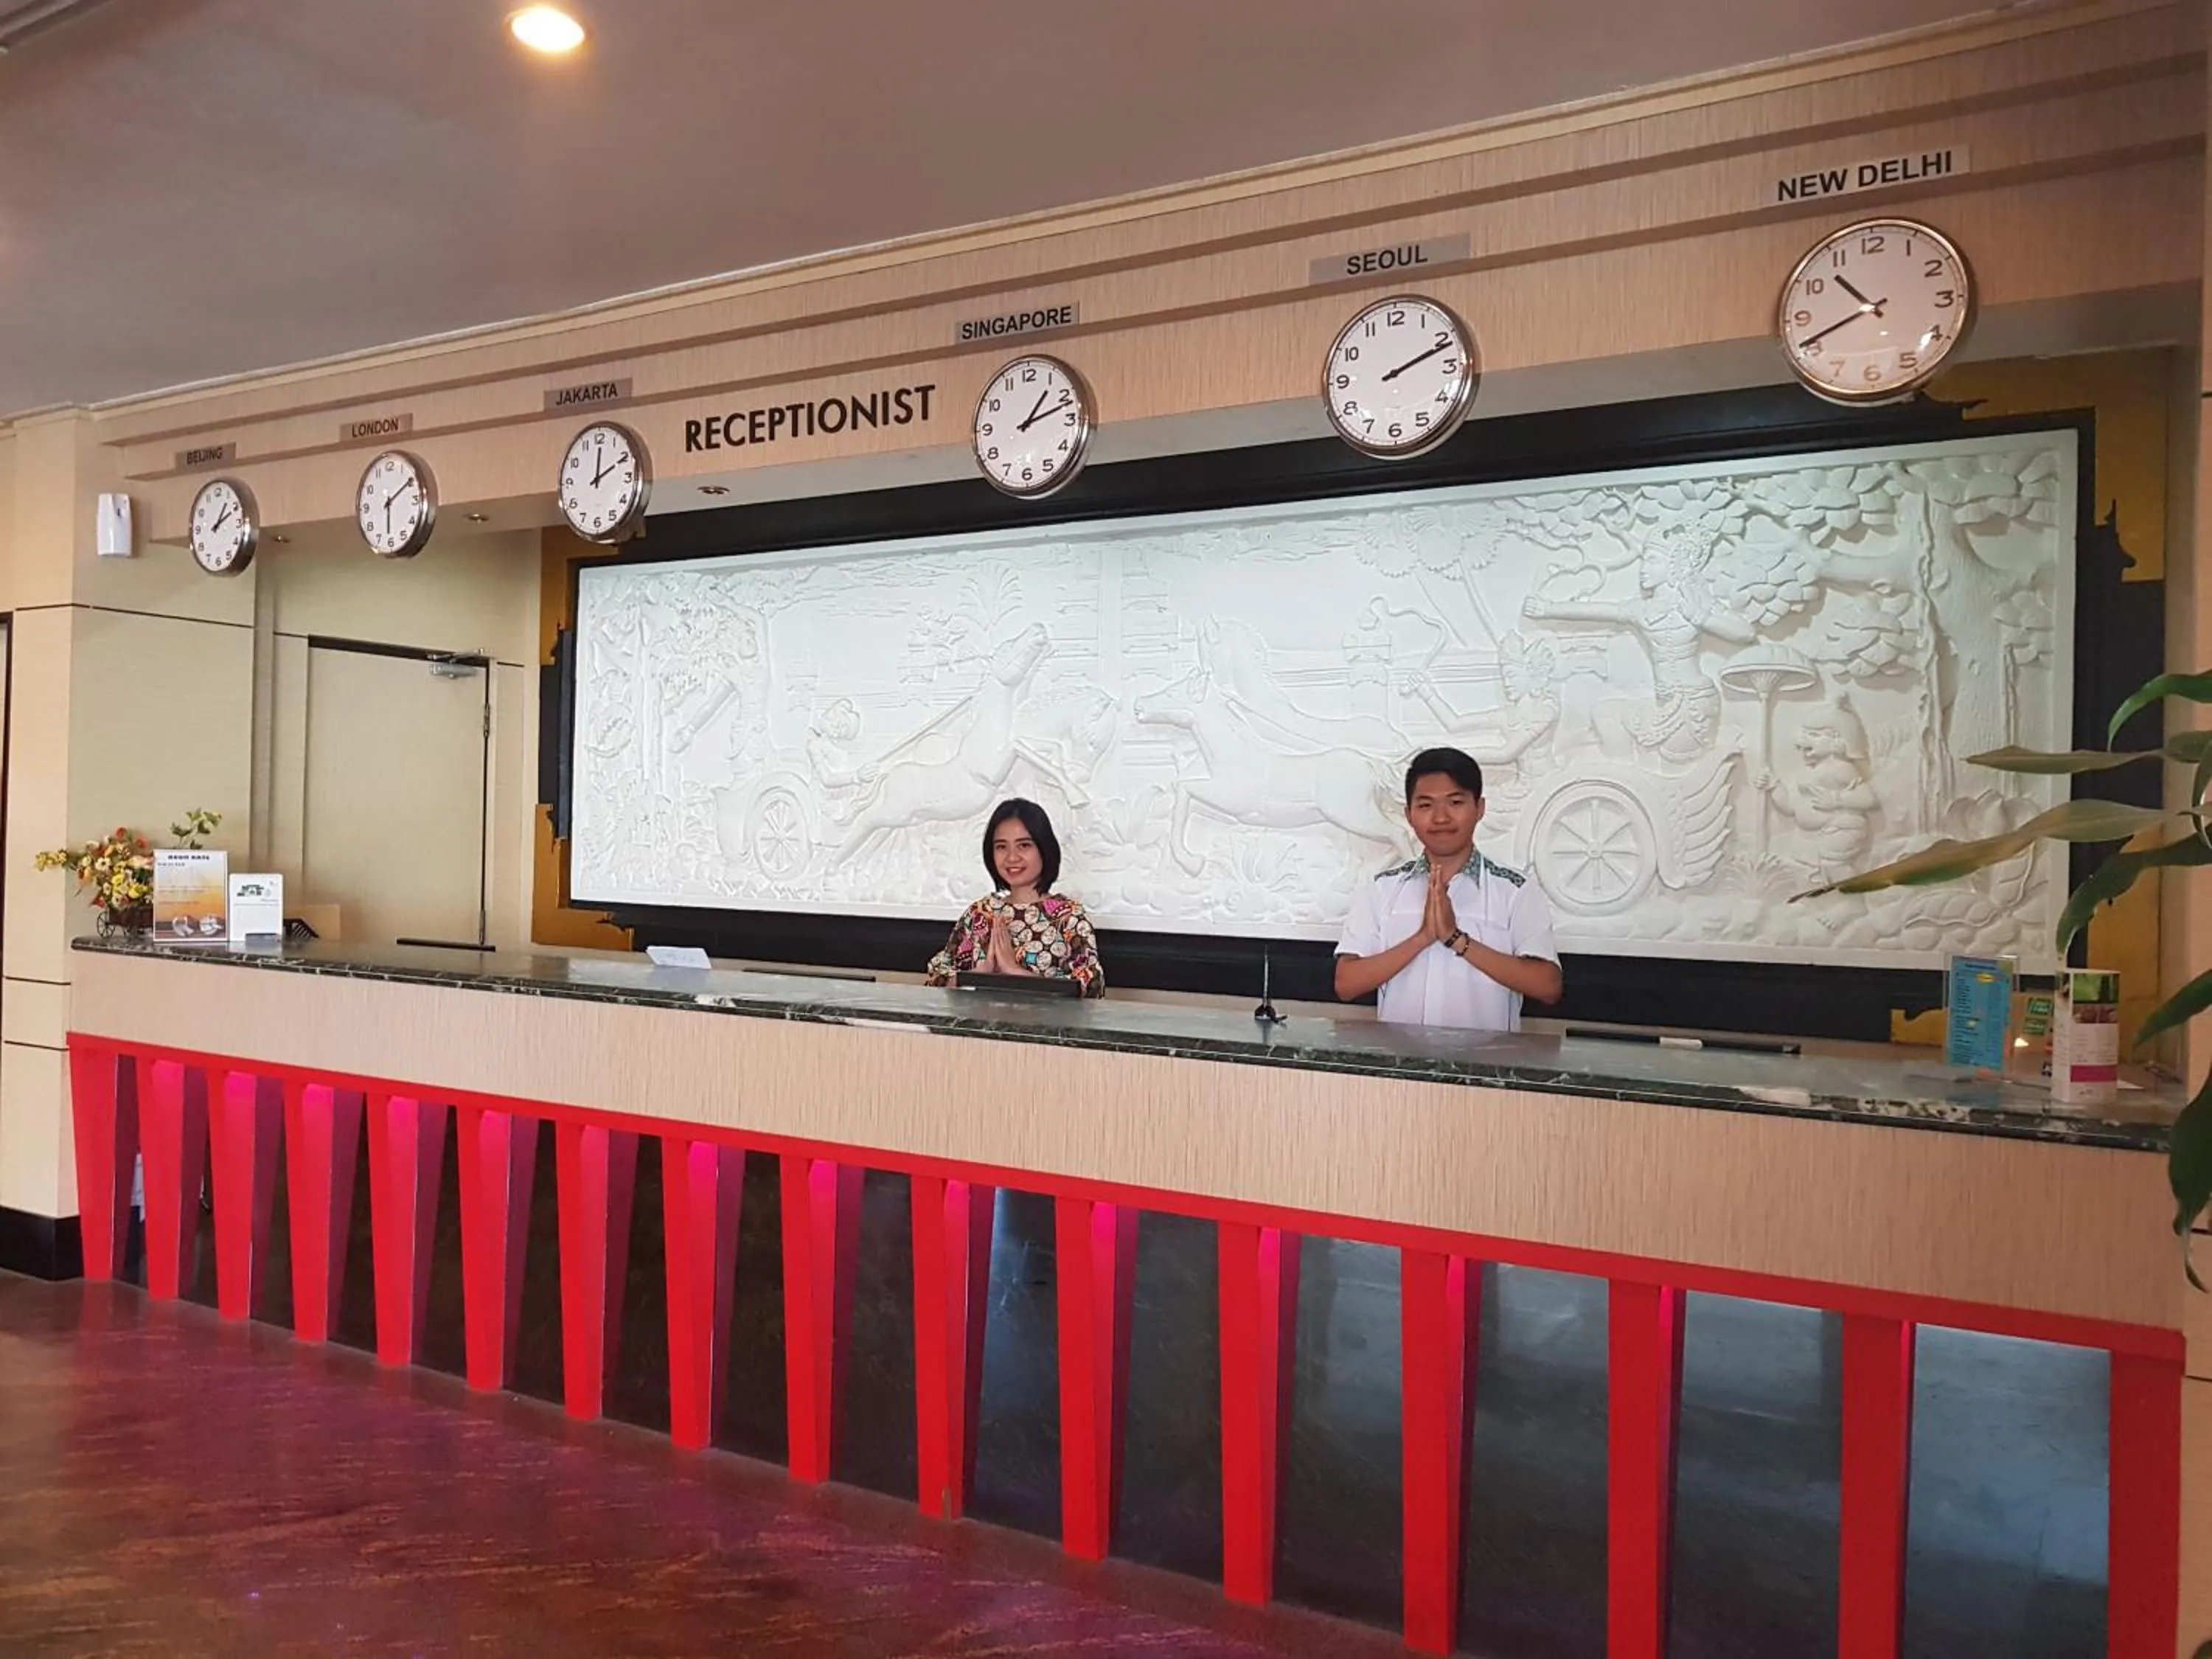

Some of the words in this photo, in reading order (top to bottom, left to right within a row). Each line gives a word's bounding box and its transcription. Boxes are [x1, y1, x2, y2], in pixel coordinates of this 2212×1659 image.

[1777, 168, 1848, 201] NEW
[1857, 150, 1952, 188] DELHI
[1861, 236, 1885, 255] 12
[1906, 240, 1911, 257] 1
[1346, 244, 1428, 275] SEOUL
[1832, 249, 1846, 268] 11
[1924, 260, 1943, 278] 2
[1806, 278, 1824, 296] 10
[1935, 290, 1955, 308] 3
[961, 306, 1072, 340] SINGAPORE
[1387, 310, 1405, 327] 12
[1421, 313, 1425, 328] 1
[1794, 310, 1812, 327] 9
[1365, 321, 1375, 337] 11
[1930, 324, 1944, 342] 4
[1344, 347, 1359, 361] 10
[1899, 351, 1918, 369] 5
[1441, 358, 1457, 375] 3
[1829, 360, 1846, 378] 7
[1863, 364, 1881, 381] 6
[1022, 369, 1037, 383] 12
[1048, 372, 1052, 385] 1
[1336, 374, 1350, 389] 9
[1005, 377, 1014, 391] 11
[556, 383, 618, 406] JAKARTA
[1059, 389, 1070, 403] 2
[1434, 389, 1449, 403] 4
[989, 399, 1001, 412] 10
[1343, 400, 1358, 416] 8
[685, 384, 936, 453] RECEPTIONIST
[1064, 412, 1076, 427] 3
[1415, 411, 1430, 427] 5
[352, 418, 398, 437] LONDON
[981, 423, 993, 436] 9
[1362, 418, 1375, 434] 7
[1388, 422, 1402, 438] 6
[594, 433, 605, 444] 12
[1058, 439, 1069, 452] 4
[987, 446, 999, 459] 8
[386, 462, 394, 472] 12
[571, 458, 578, 469] 10
[1002, 463, 1012, 476] 7
[1042, 459, 1054, 472] 5
[625, 472, 633, 484] 3
[1021, 467, 1032, 481] 6
[366, 485, 373, 494] 10
[566, 478, 574, 489] 9
[412, 495, 418, 505] 3
[569, 498, 578, 509] 8
[619, 493, 627, 504] 4
[363, 504, 369, 513] 9
[608, 510, 616, 521] 5
[408, 516, 414, 524] 4
[580, 512, 587, 523] 7
[594, 518, 602, 528] 6
[367, 522, 373, 531] 8
[376, 534, 382, 544] 7
[388, 538, 394, 547] 6
[400, 531, 407, 540] 5
